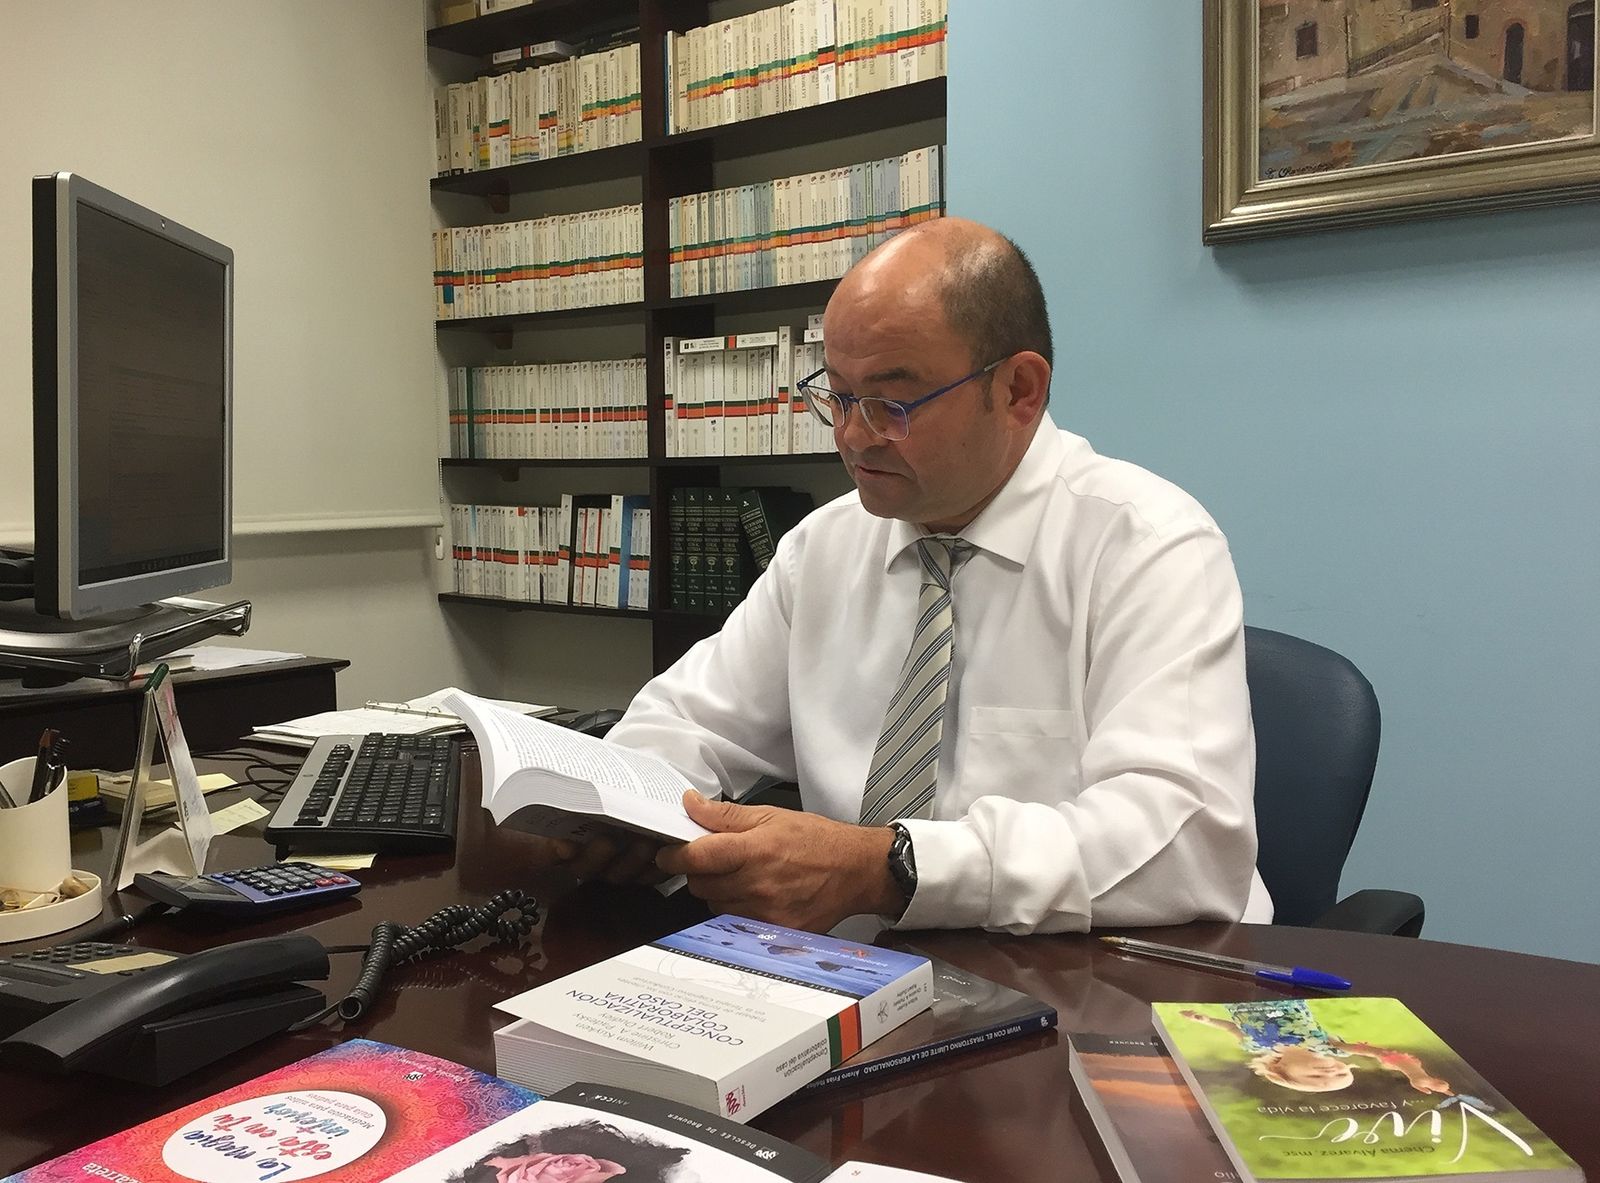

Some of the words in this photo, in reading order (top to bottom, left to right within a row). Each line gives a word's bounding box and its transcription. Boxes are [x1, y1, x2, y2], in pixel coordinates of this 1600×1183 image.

[637, 993, 682, 1010] CASO
[566, 990, 744, 1046] CONCEPTUALIZACIÓN
[605, 992, 728, 1032] COLABORATIVA
[686, 1006, 719, 1020] DEL
[985, 1032, 993, 1040] EL
[994, 1028, 1007, 1038] CON
[1006, 1025, 1022, 1035] VIVIR
[796, 1038, 828, 1060] colaborativa
[930, 1044, 950, 1058] LÍMITE
[949, 1034, 984, 1051] TRASTORNO
[783, 1047, 829, 1078] Conceptualización
[787, 1053, 797, 1063] del
[910, 1052, 920, 1062] LA
[921, 1050, 930, 1058] DE
[775, 1059, 788, 1073] caso
[863, 1055, 911, 1075] PERSONALIDAD
[1257, 1104, 1296, 1116] vida
[1298, 1104, 1317, 1115] la
[1318, 1099, 1398, 1115] favorece
[211, 1112, 252, 1133] tu
[262, 1102, 350, 1140] interior
[666, 1112, 703, 1130] BROUWER
[244, 1122, 278, 1139] en
[705, 1125, 717, 1135] DE
[1258, 1101, 1534, 1165] Vive
[182, 1128, 257, 1160] magia
[264, 1135, 333, 1161] está
[720, 1131, 756, 1150] DESCLÉE
[1379, 1144, 1436, 1157] Chema
[255, 1157, 292, 1181] La
